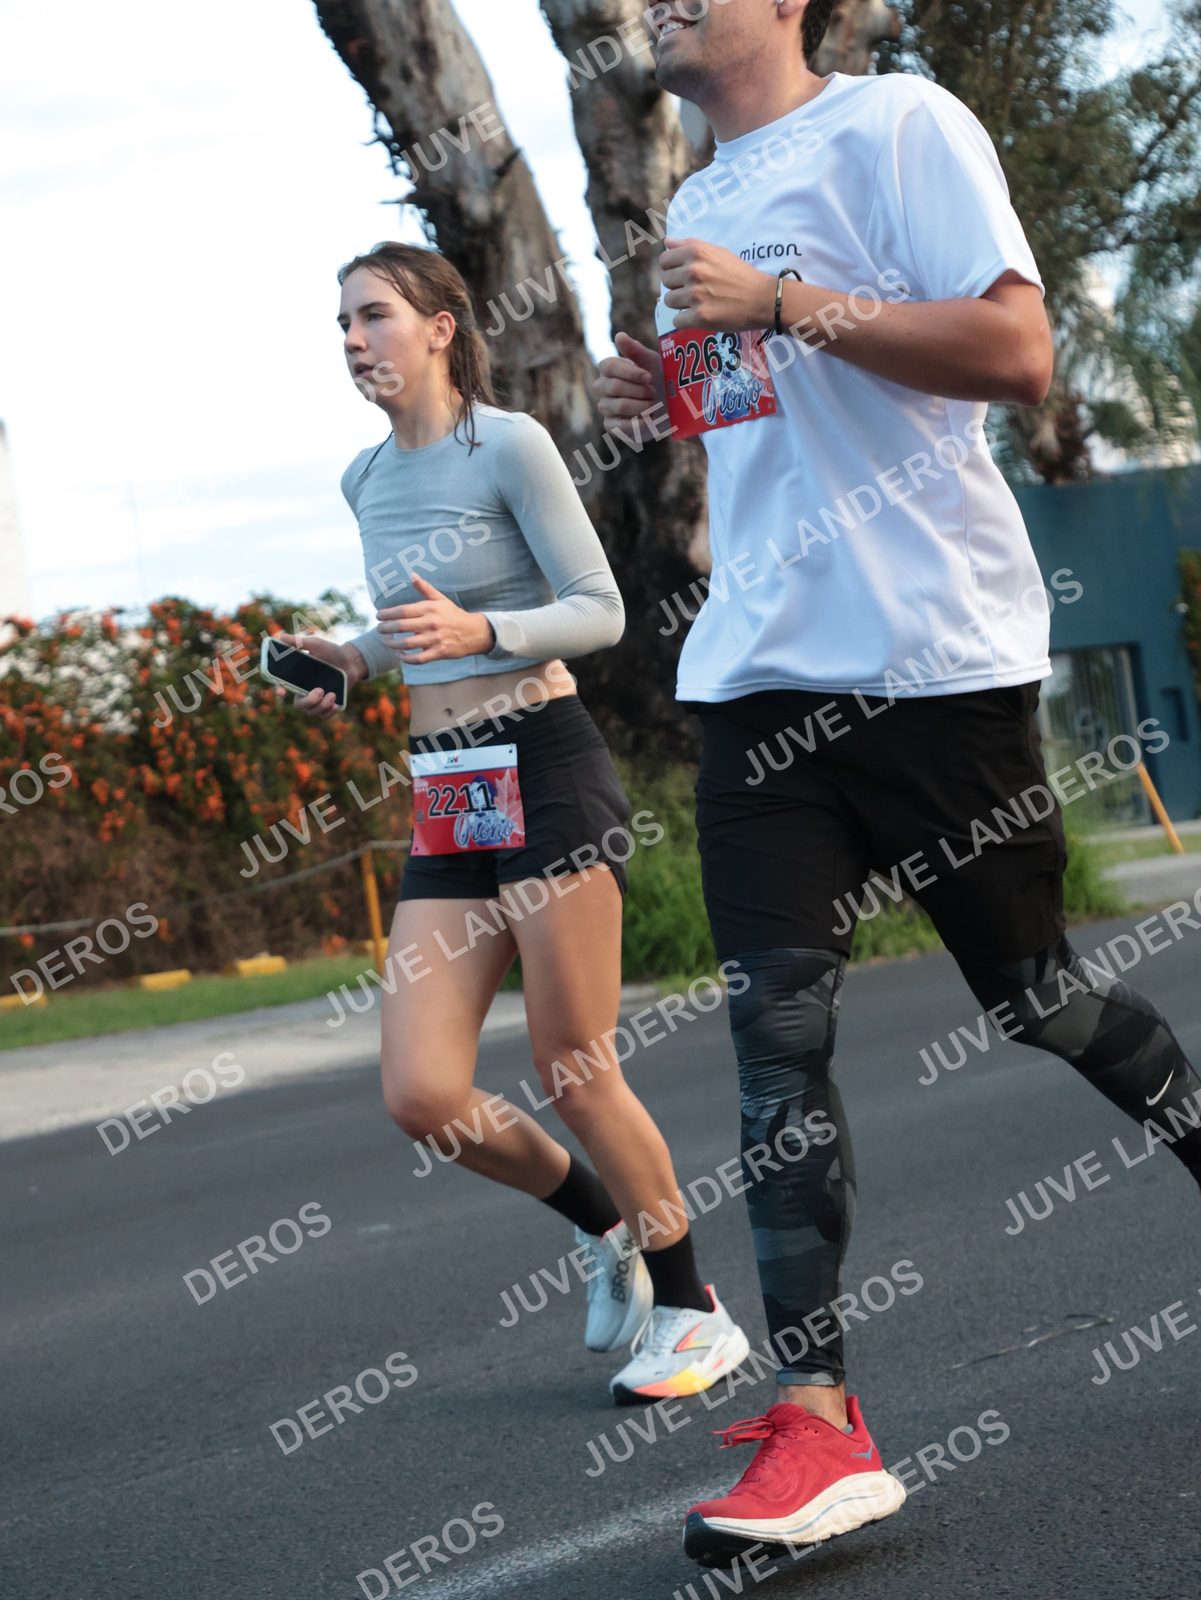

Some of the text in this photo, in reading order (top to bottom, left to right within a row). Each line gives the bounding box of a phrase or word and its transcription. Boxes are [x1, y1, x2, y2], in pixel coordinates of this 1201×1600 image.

[740, 242, 802, 261] micron
[674, 332, 741, 389] 2263
[428, 782, 497, 819] 2211
